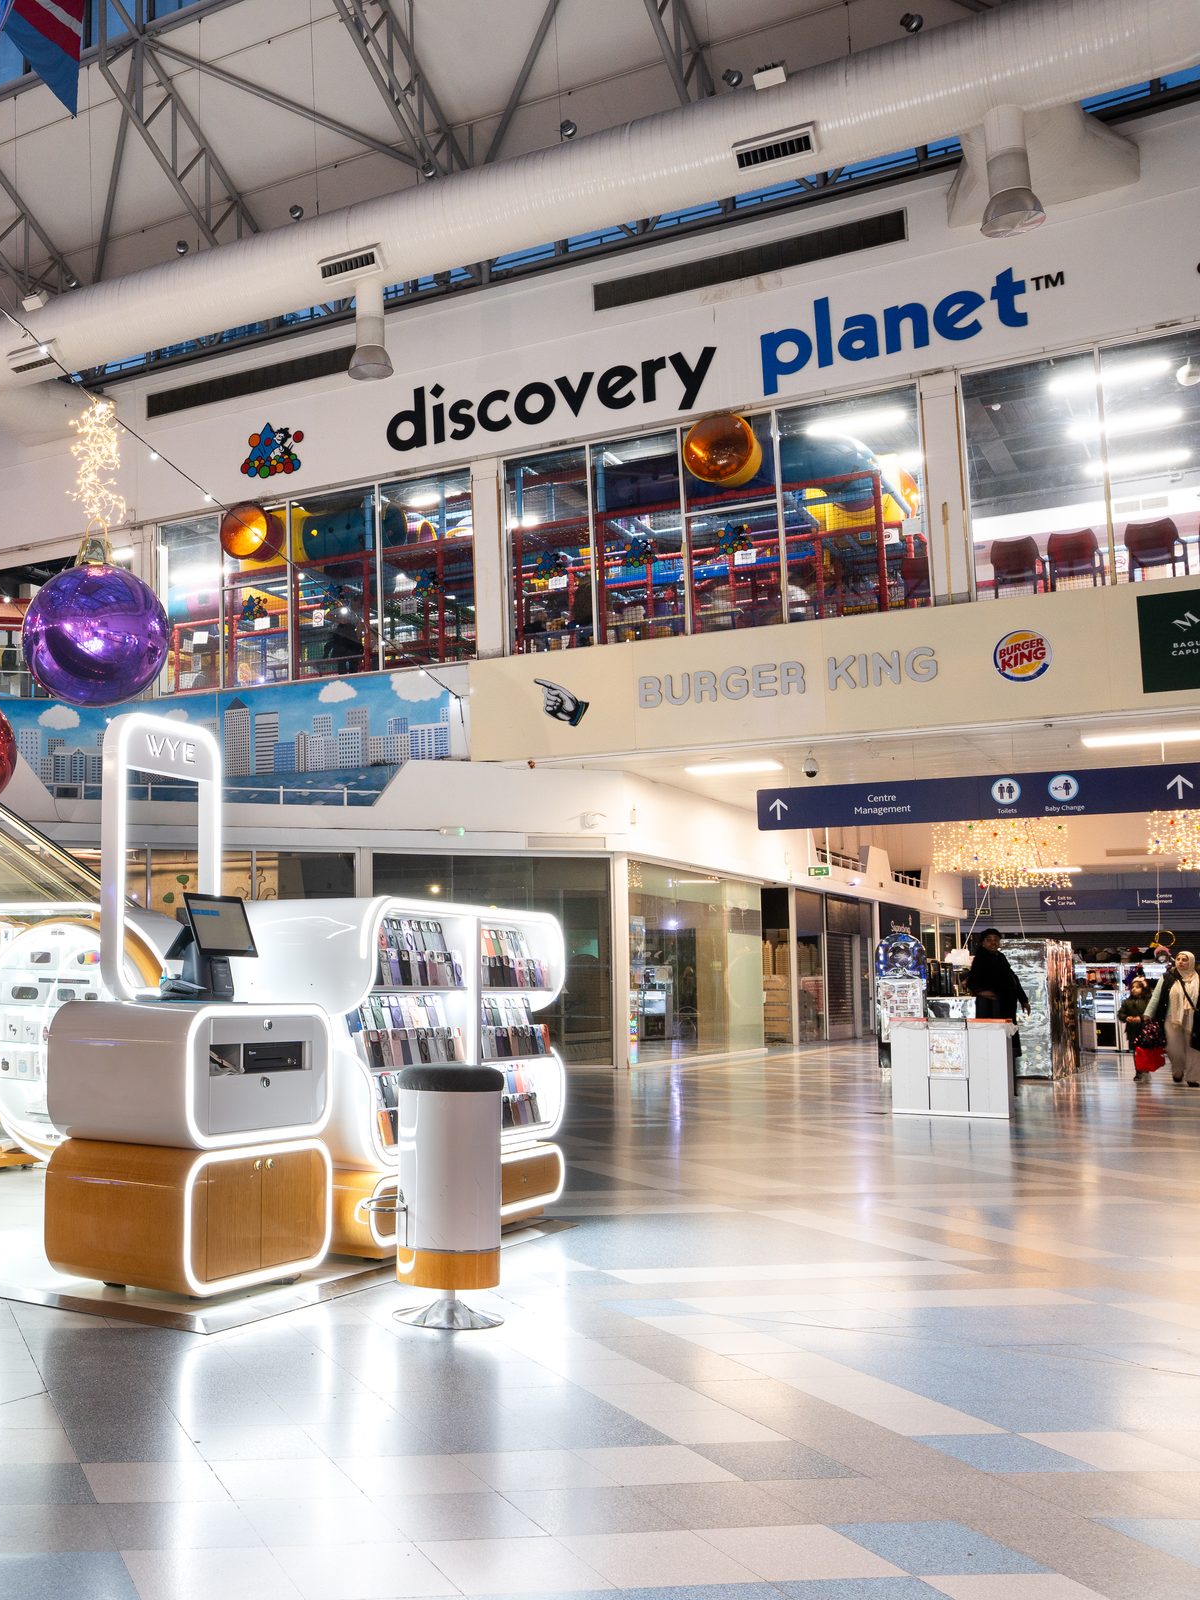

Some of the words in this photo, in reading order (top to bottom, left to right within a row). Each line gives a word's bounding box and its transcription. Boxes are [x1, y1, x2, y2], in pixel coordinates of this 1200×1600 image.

[386, 346, 716, 452] discovery
[760, 266, 1029, 396] planet
[999, 637, 1045, 660] BURGER
[1000, 646, 1047, 673] KING
[638, 660, 806, 709] BURGER
[827, 646, 939, 691] KING
[145, 734, 196, 764] WYE
[854, 804, 912, 816] Management
[867, 794, 897, 803] Centre
[1044, 805, 1060, 813] Baby
[1061, 804, 1086, 812] Change
